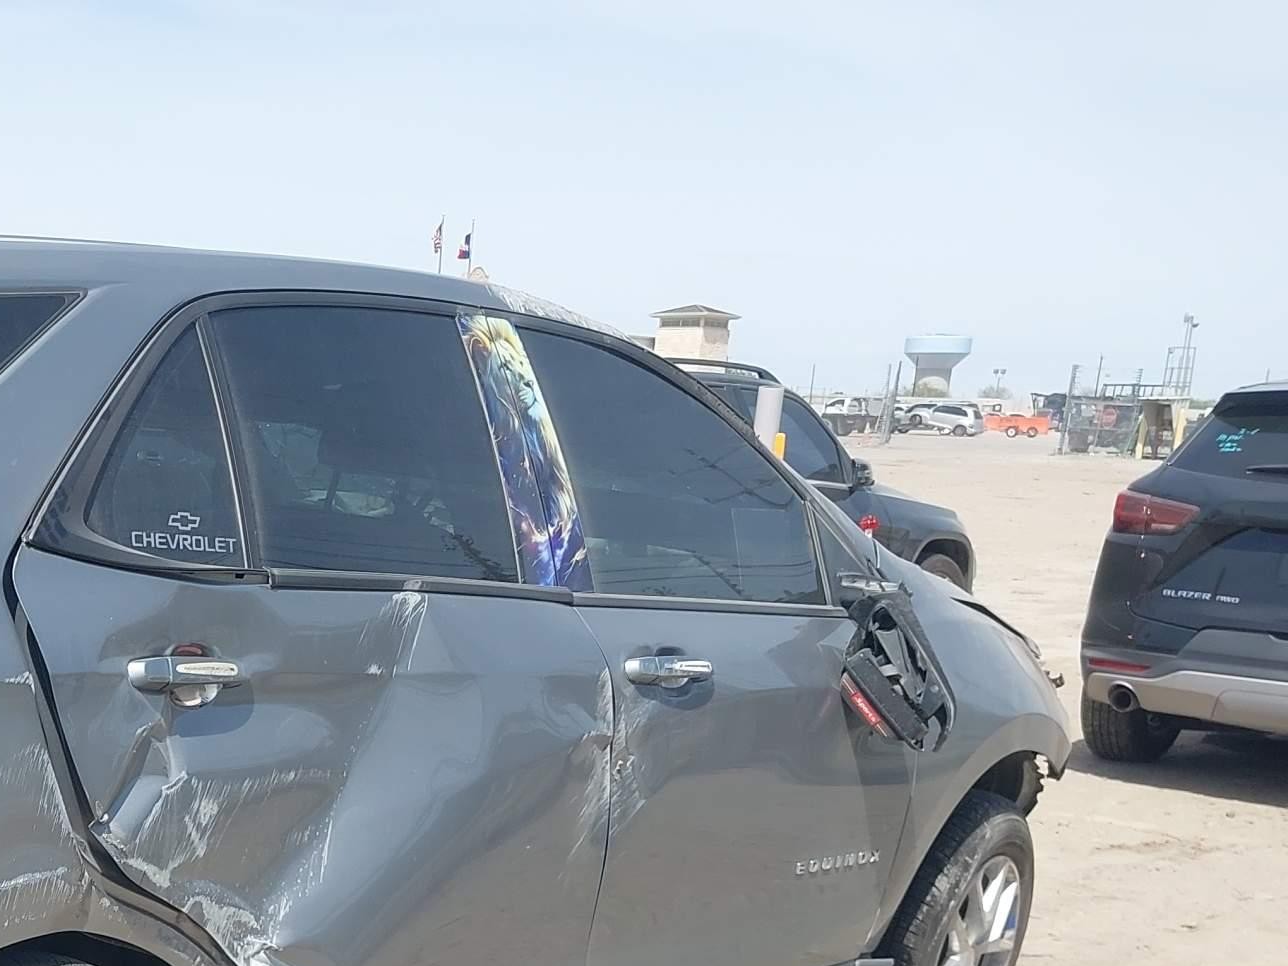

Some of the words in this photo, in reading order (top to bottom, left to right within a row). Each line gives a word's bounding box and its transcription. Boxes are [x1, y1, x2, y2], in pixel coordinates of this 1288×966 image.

[131, 531, 237, 553] CHEVROLET
[1162, 588, 1212, 601] BLAZER
[795, 850, 880, 875] EQUINOX
